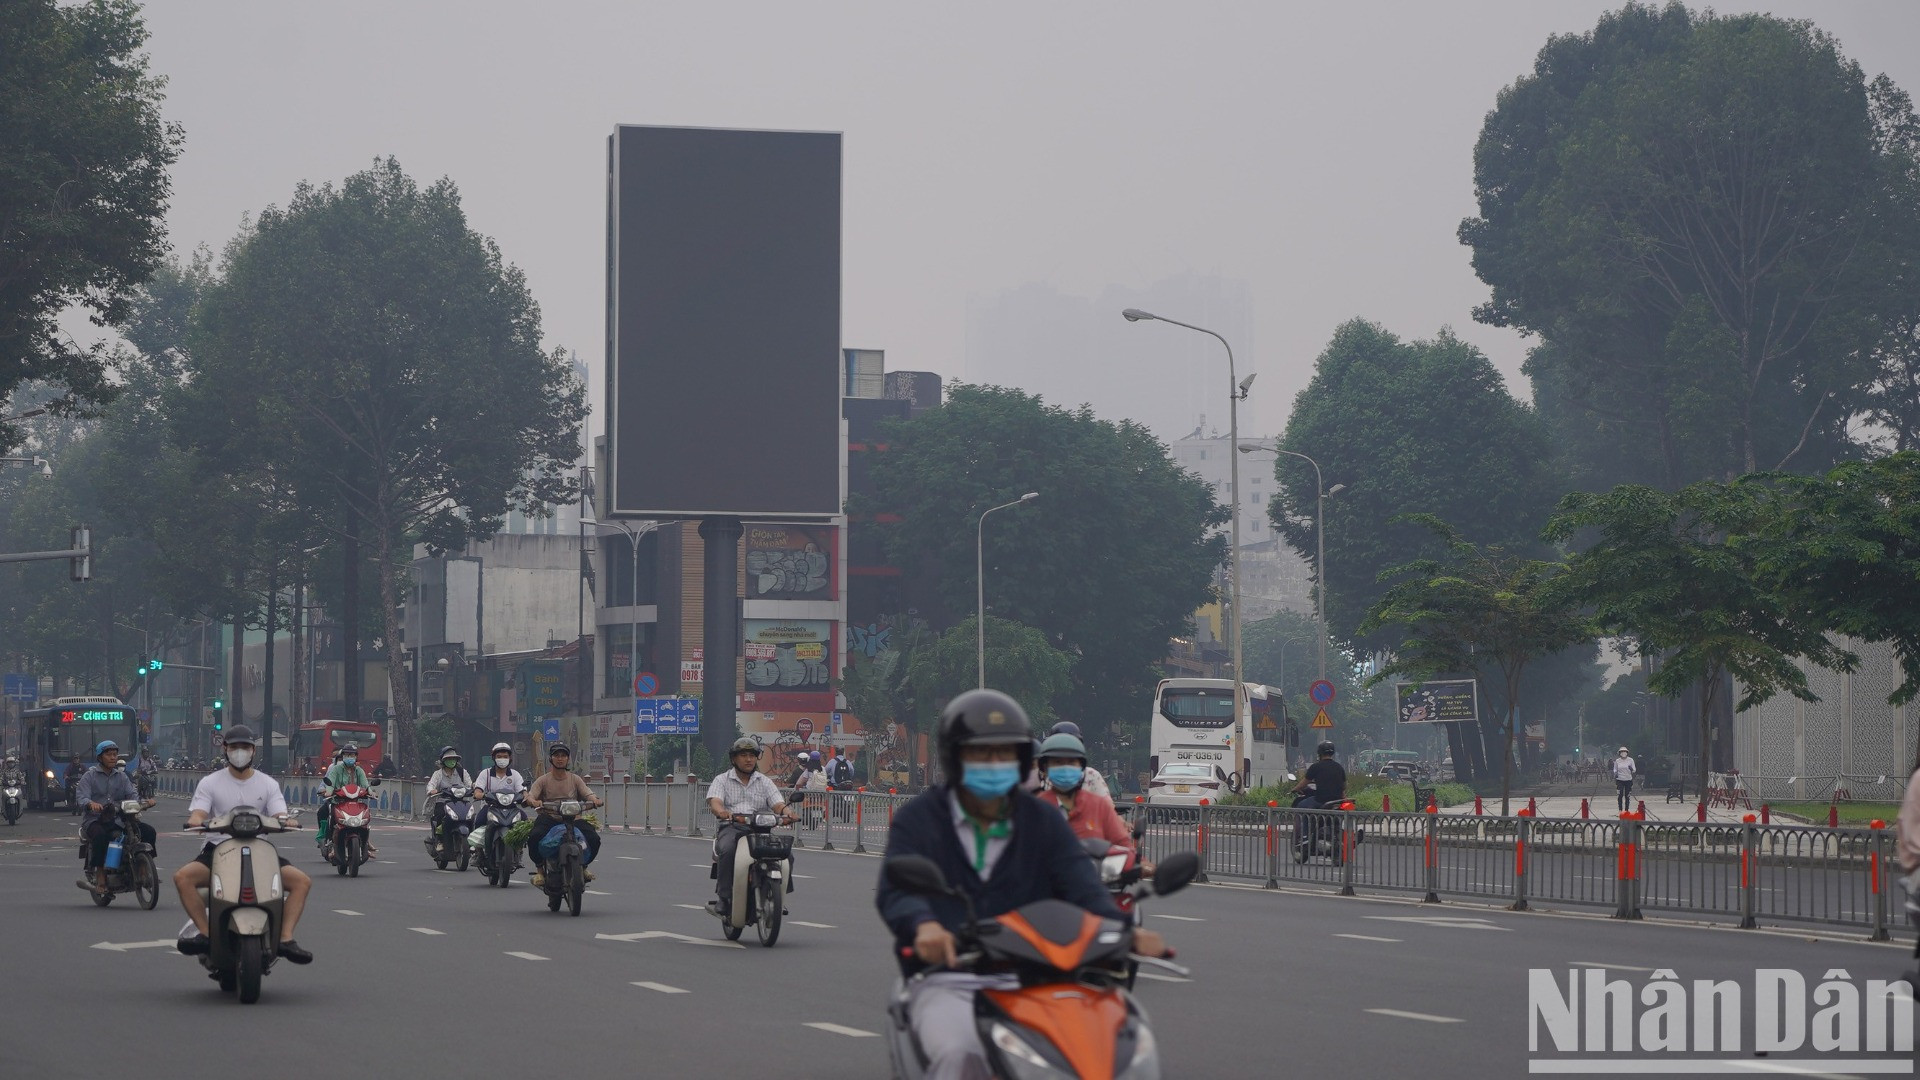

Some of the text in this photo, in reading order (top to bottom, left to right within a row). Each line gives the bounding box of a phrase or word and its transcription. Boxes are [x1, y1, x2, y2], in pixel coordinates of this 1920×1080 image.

[150, 660, 163, 670] 34
[681, 669, 699, 681] 0978
[535, 697, 559, 707] Chay
[1177, 751, 1223, 761] 50F-036.10
